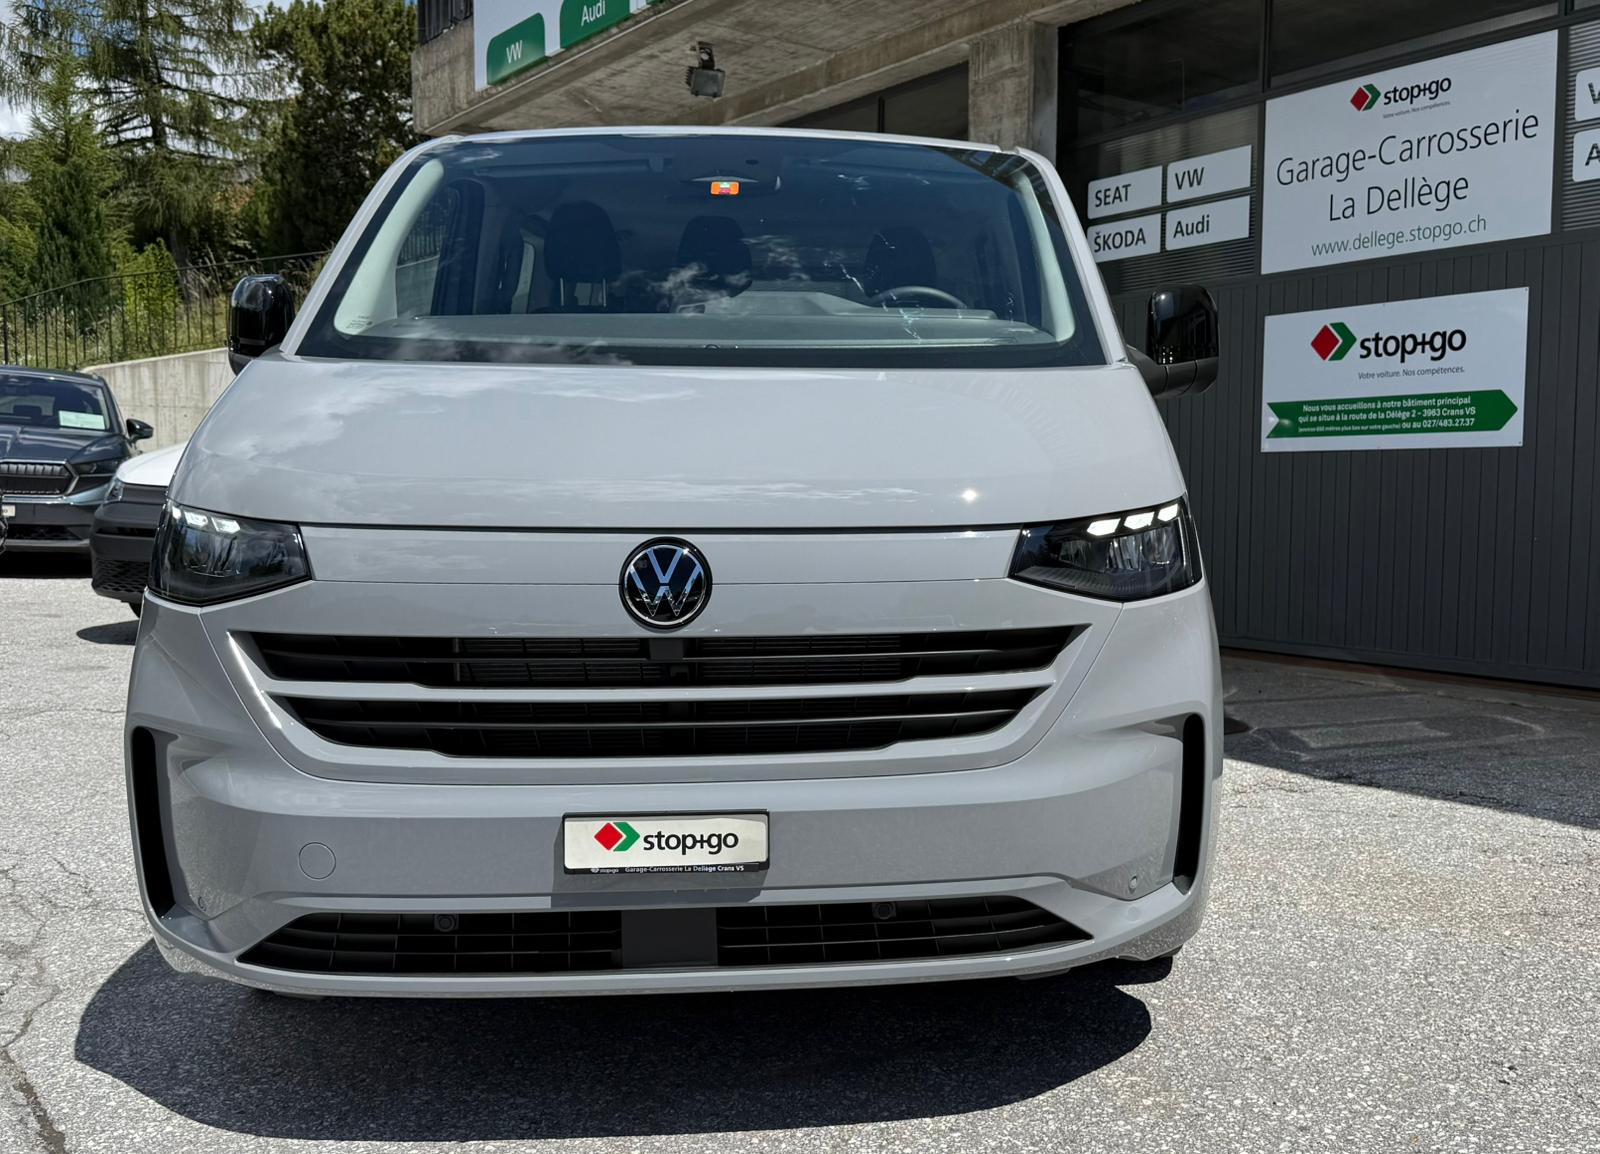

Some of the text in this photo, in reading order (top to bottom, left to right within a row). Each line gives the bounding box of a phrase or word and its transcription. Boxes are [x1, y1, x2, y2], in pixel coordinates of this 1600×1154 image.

[581, 0, 606, 27] Audi
[506, 40, 523, 64] VW
[1383, 77, 1452, 105] stop+go
[1276, 109, 1539, 186] Garage-Carrosserie
[1175, 167, 1205, 190] VW
[1095, 184, 1132, 208] SEAT
[1329, 176, 1469, 222] La Dellège
[1173, 214, 1210, 239] Audi
[1311, 214, 1487, 256] www.dellege.stopgo.ch
[1093, 228, 1147, 253] ŠKODA
[1359, 329, 1467, 363] stop+go
[1358, 371, 1376, 380] Votre
[1402, 368, 1416, 377] Nos
[1298, 415, 1309, 424] qui
[1318, 413, 1336, 422] situe
[1341, 412, 1348, 421] la
[1348, 411, 1368, 420] route
[1368, 411, 1378, 420] de
[1377, 411, 1386, 419] la
[1411, 409, 1417, 418] 2
[1422, 408, 1441, 417] 3963
[1441, 407, 1465, 416] Crans
[1465, 406, 1476, 415] VS
[1303, 404, 1320, 413] Nous
[1320, 404, 1336, 412] vous
[1382, 400, 1401, 408] notre
[1402, 398, 1436, 407] bâtiment
[1436, 395, 1471, 407] principal
[643, 830, 739, 855] stop+go
[717, 864, 735, 872] Crans
